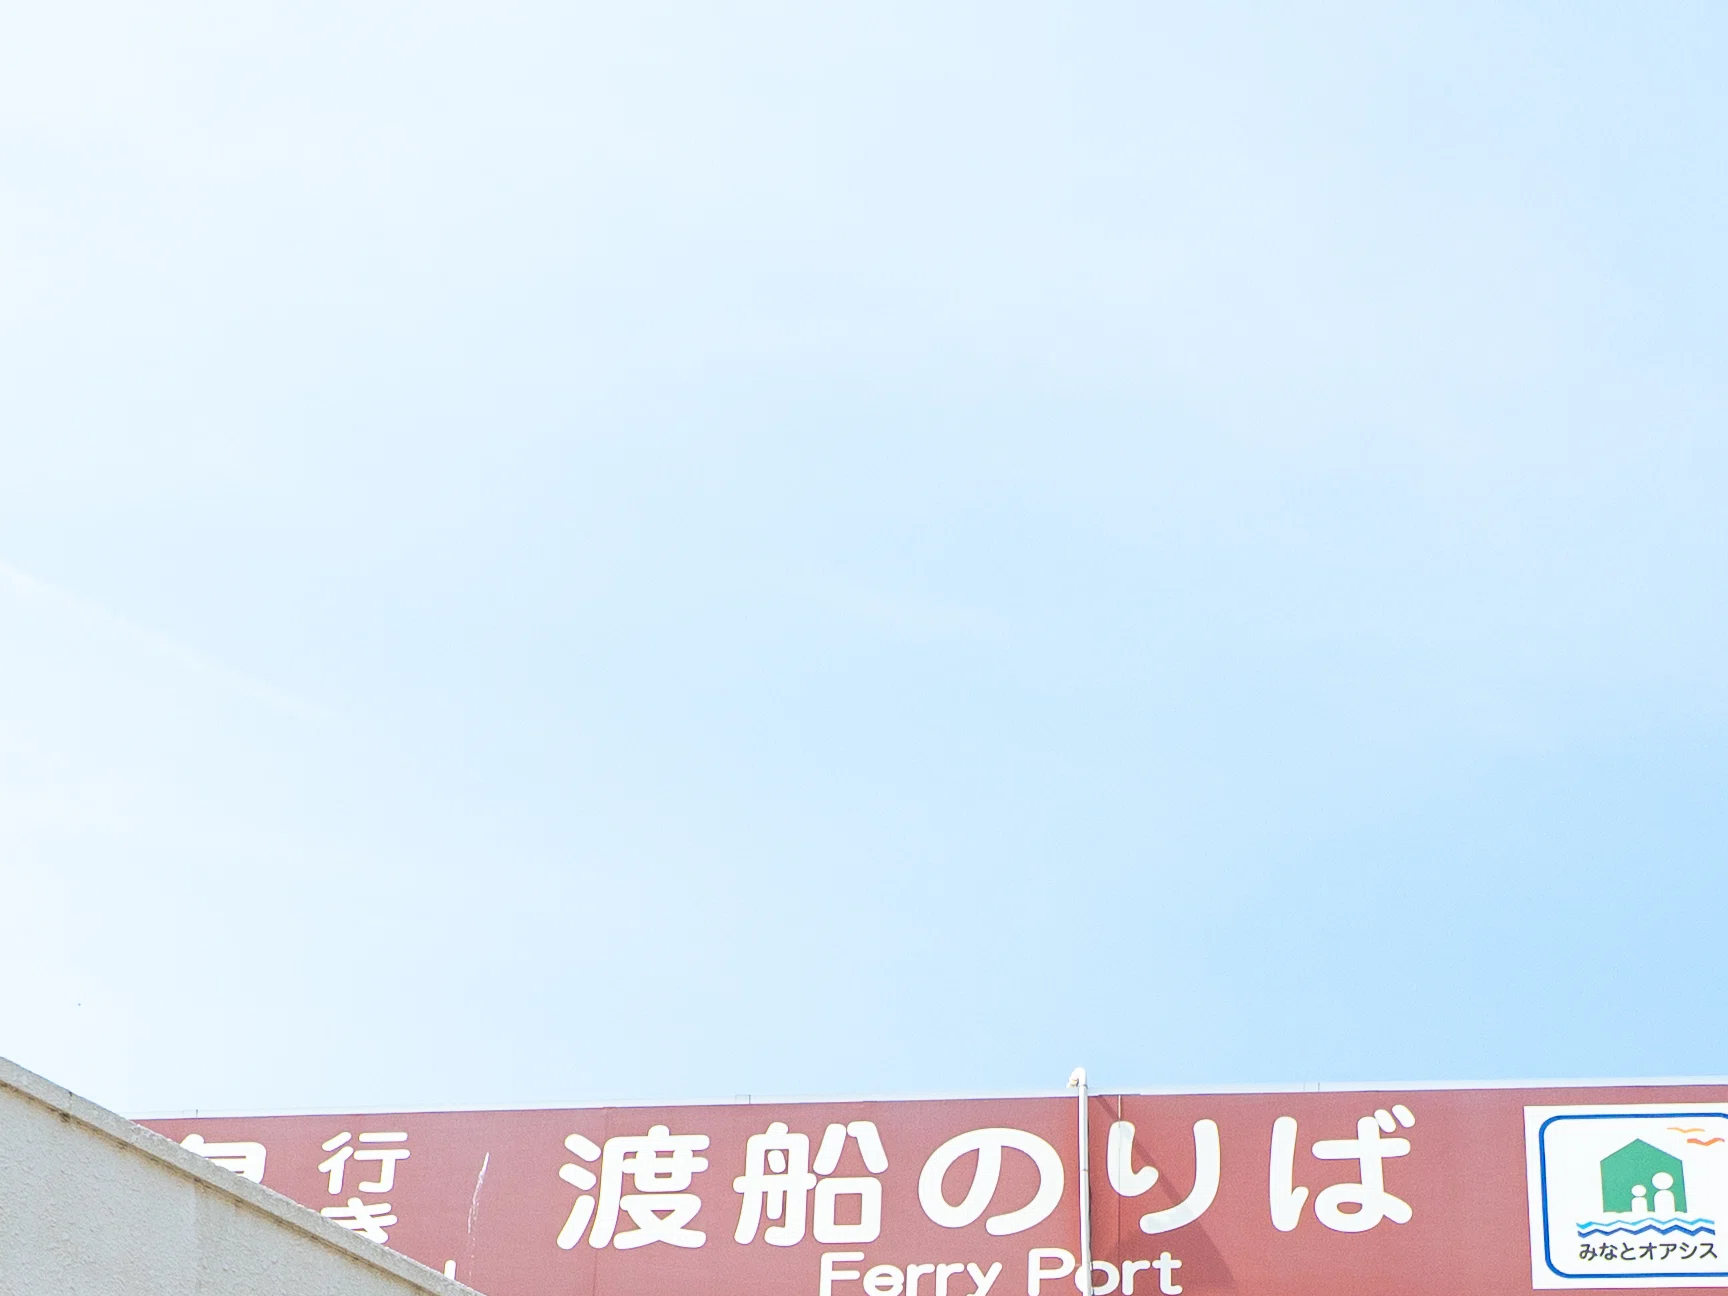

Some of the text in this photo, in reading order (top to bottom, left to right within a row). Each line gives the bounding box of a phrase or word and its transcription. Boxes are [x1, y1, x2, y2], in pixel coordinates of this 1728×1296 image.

[556, 1103, 1414, 1250] 渡船のりば
[1578, 1238, 1719, 1263] みなとオアシス
